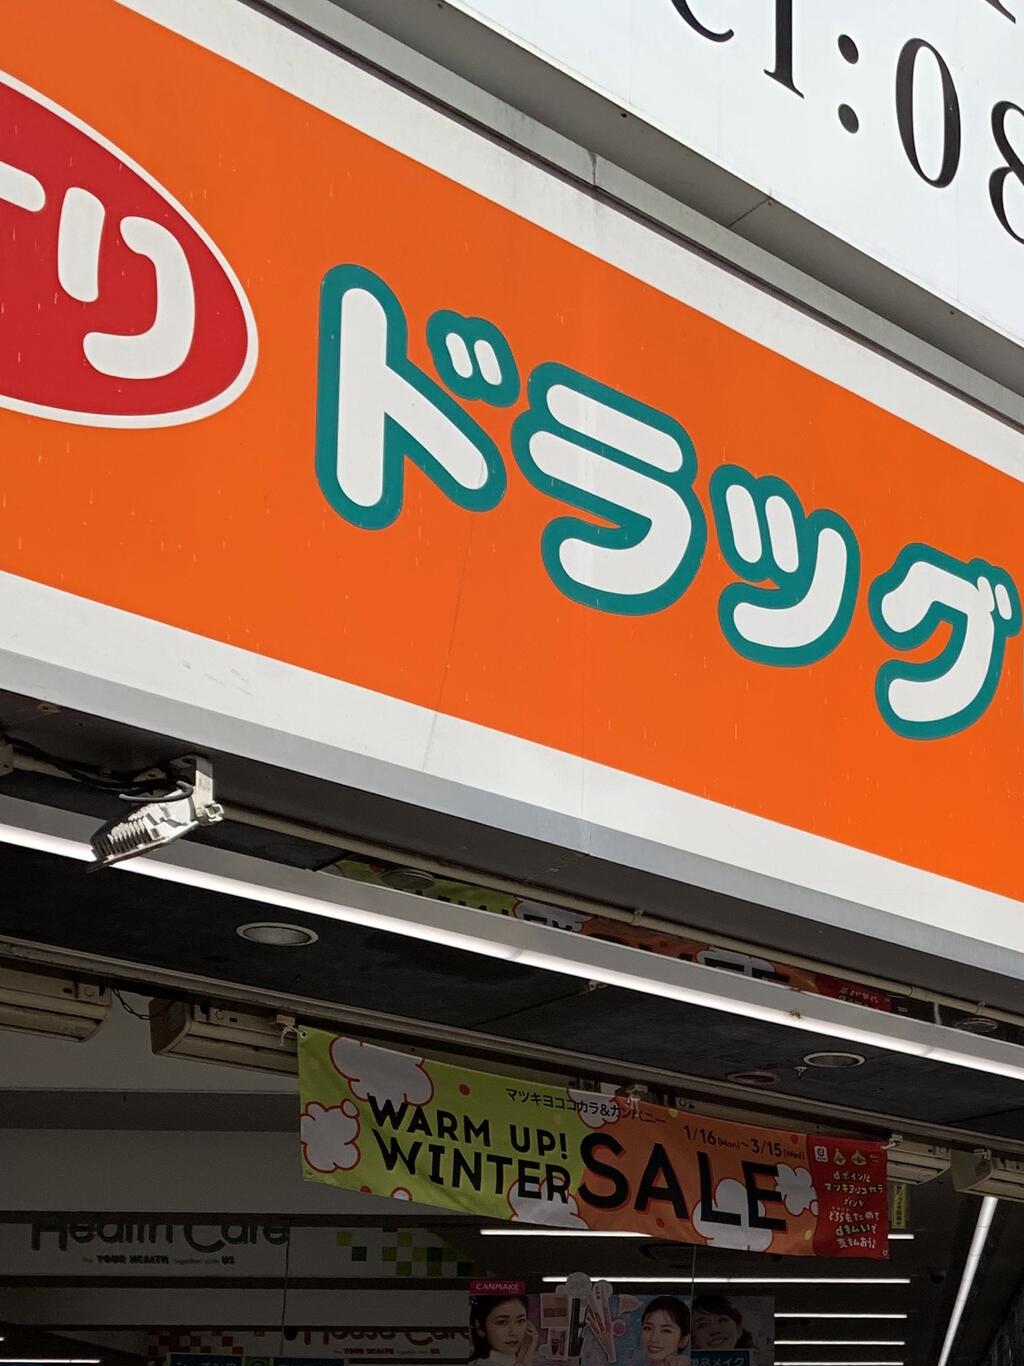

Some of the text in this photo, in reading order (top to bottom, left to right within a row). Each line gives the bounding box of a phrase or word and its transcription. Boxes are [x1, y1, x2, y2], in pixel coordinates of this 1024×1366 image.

[0, 160, 196, 380] り
[320, 268, 1018, 738] ドラッグ
[368, 1094, 568, 1160] WARM UP!
[372, 1129, 787, 1231] WINTER SALE
[476, 1282, 520, 1291] CANMAKE
